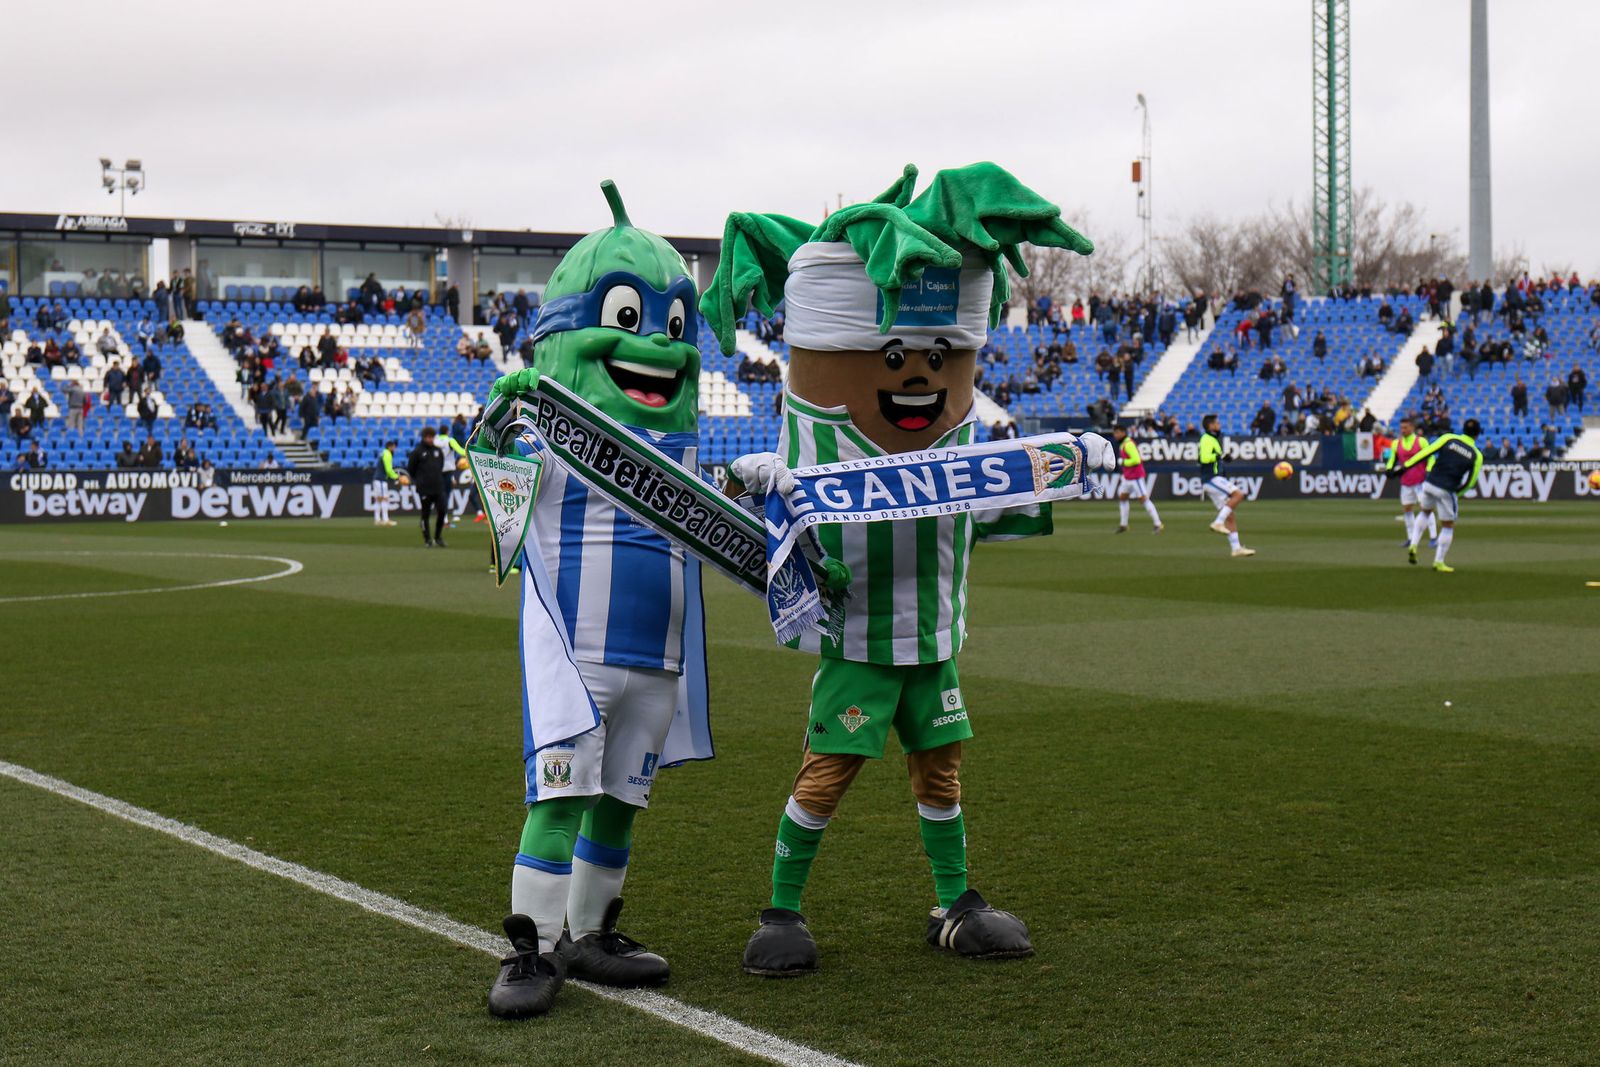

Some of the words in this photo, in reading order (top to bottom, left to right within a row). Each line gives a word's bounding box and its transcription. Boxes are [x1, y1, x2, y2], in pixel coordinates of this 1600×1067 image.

[841, 452, 938, 471] DEPORTIVO
[1138, 437, 1201, 462] etwa
[1222, 436, 1320, 466] betway
[10, 473, 77, 491] CIUDAD
[83, 479, 99, 489] DEL
[105, 467, 198, 489] AUTOMÓVI
[231, 471, 311, 483] Mercedes-Benz
[1300, 470, 1387, 500] betway
[25, 488, 147, 522] betway
[800, 512, 872, 527] SOÑANDO
[880, 507, 929, 519] DESDE
[938, 502, 971, 514] 1928
